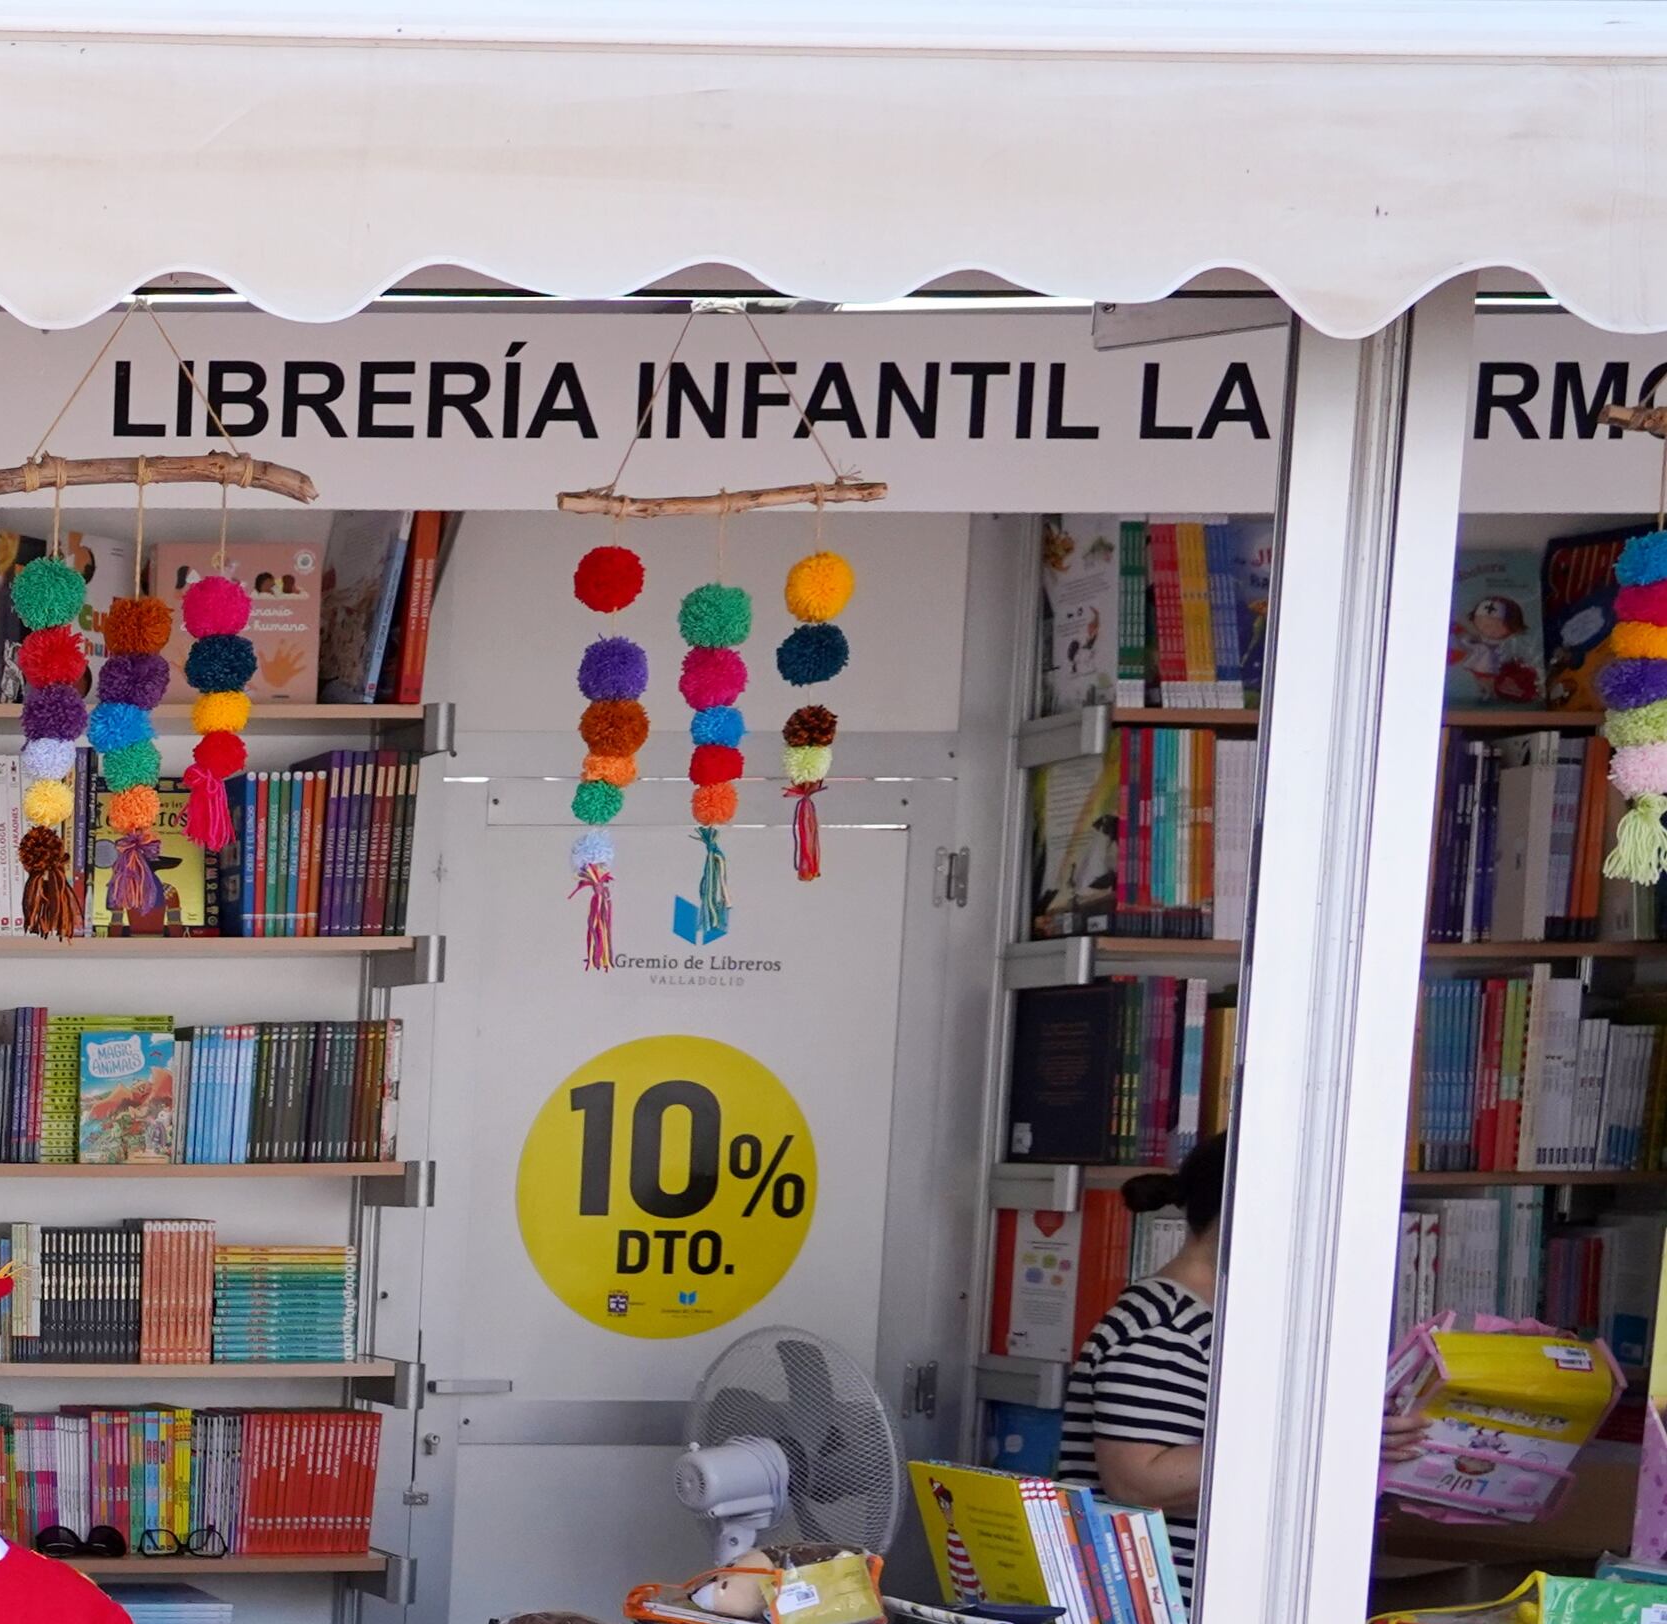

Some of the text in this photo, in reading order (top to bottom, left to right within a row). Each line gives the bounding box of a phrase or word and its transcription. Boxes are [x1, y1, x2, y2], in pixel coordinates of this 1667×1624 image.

[113, 341, 1271, 440] LIBRERÍA INFANTIL LA
[325, 828, 335, 860] EGIPCIOS
[348, 830, 357, 861] GRIEGOS
[369, 823, 380, 860] ROMANOS
[615, 953, 782, 972] Gremio de Libreros
[650, 975, 745, 986] VALLADOLID
[93, 1053, 142, 1074] ANIMALS
[98, 1043, 132, 1060] MAGIC
[570, 1081, 806, 1219] 10%
[616, 1229, 735, 1275] DTO.
[1435, 1474, 1489, 1497] Lulú
